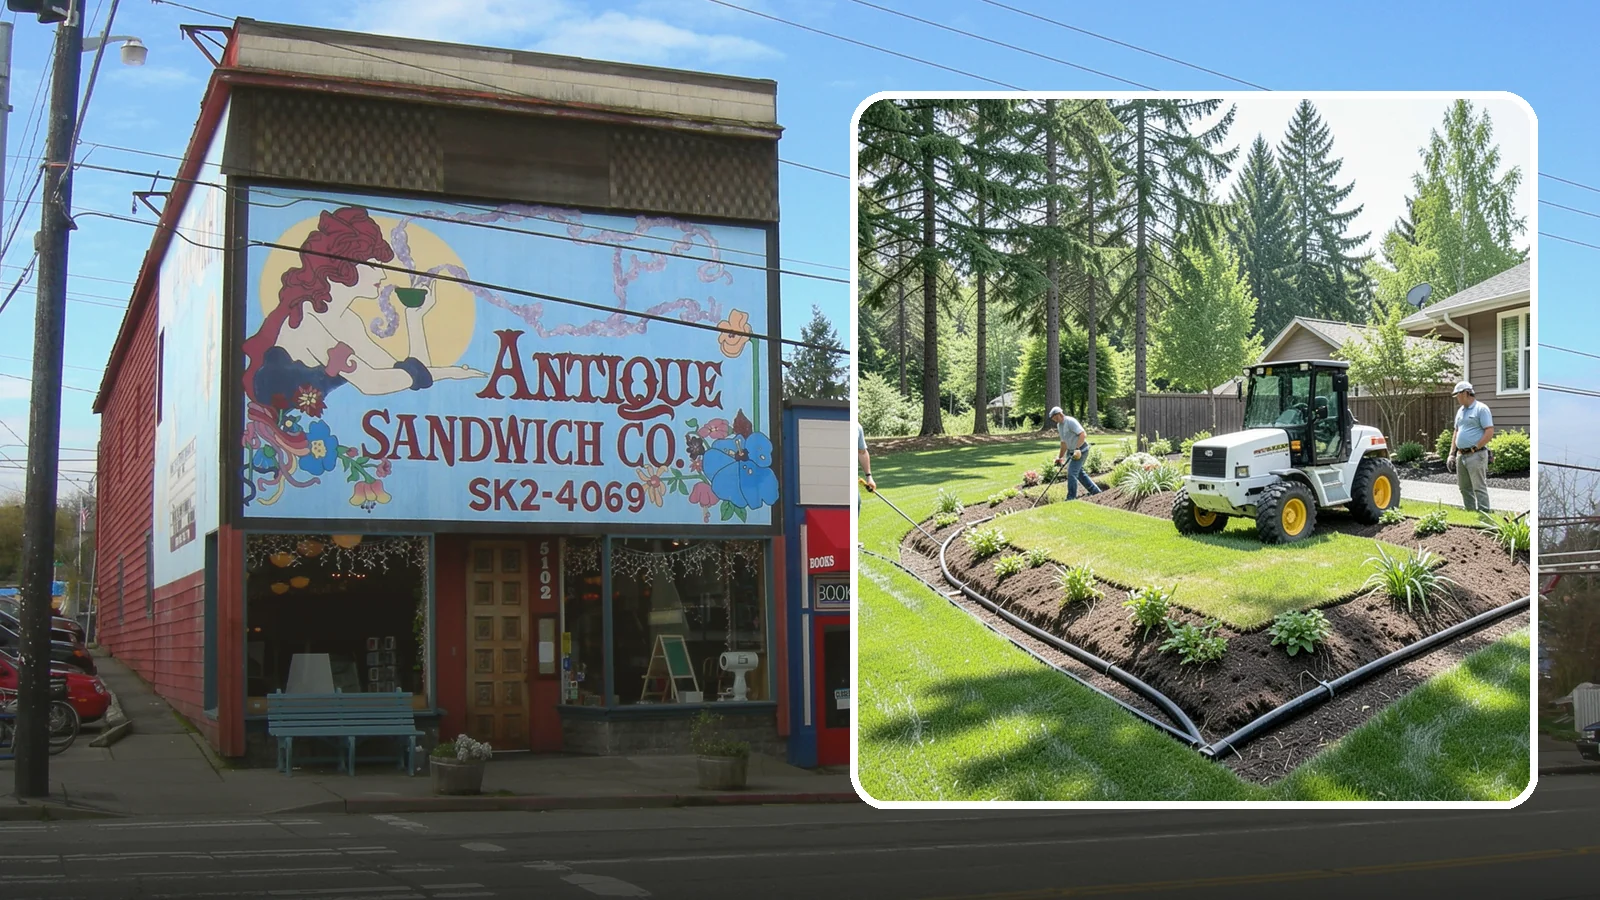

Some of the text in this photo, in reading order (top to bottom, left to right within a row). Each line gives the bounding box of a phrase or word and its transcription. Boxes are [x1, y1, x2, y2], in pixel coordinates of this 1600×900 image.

[476, 329, 723, 421] ANTIQUE
[361, 408, 685, 469] SANDWICH CO.
[468, 477, 645, 513] SK2-4069
[539, 542, 552, 599] 5102
[809, 555, 835, 569] BOOKS
